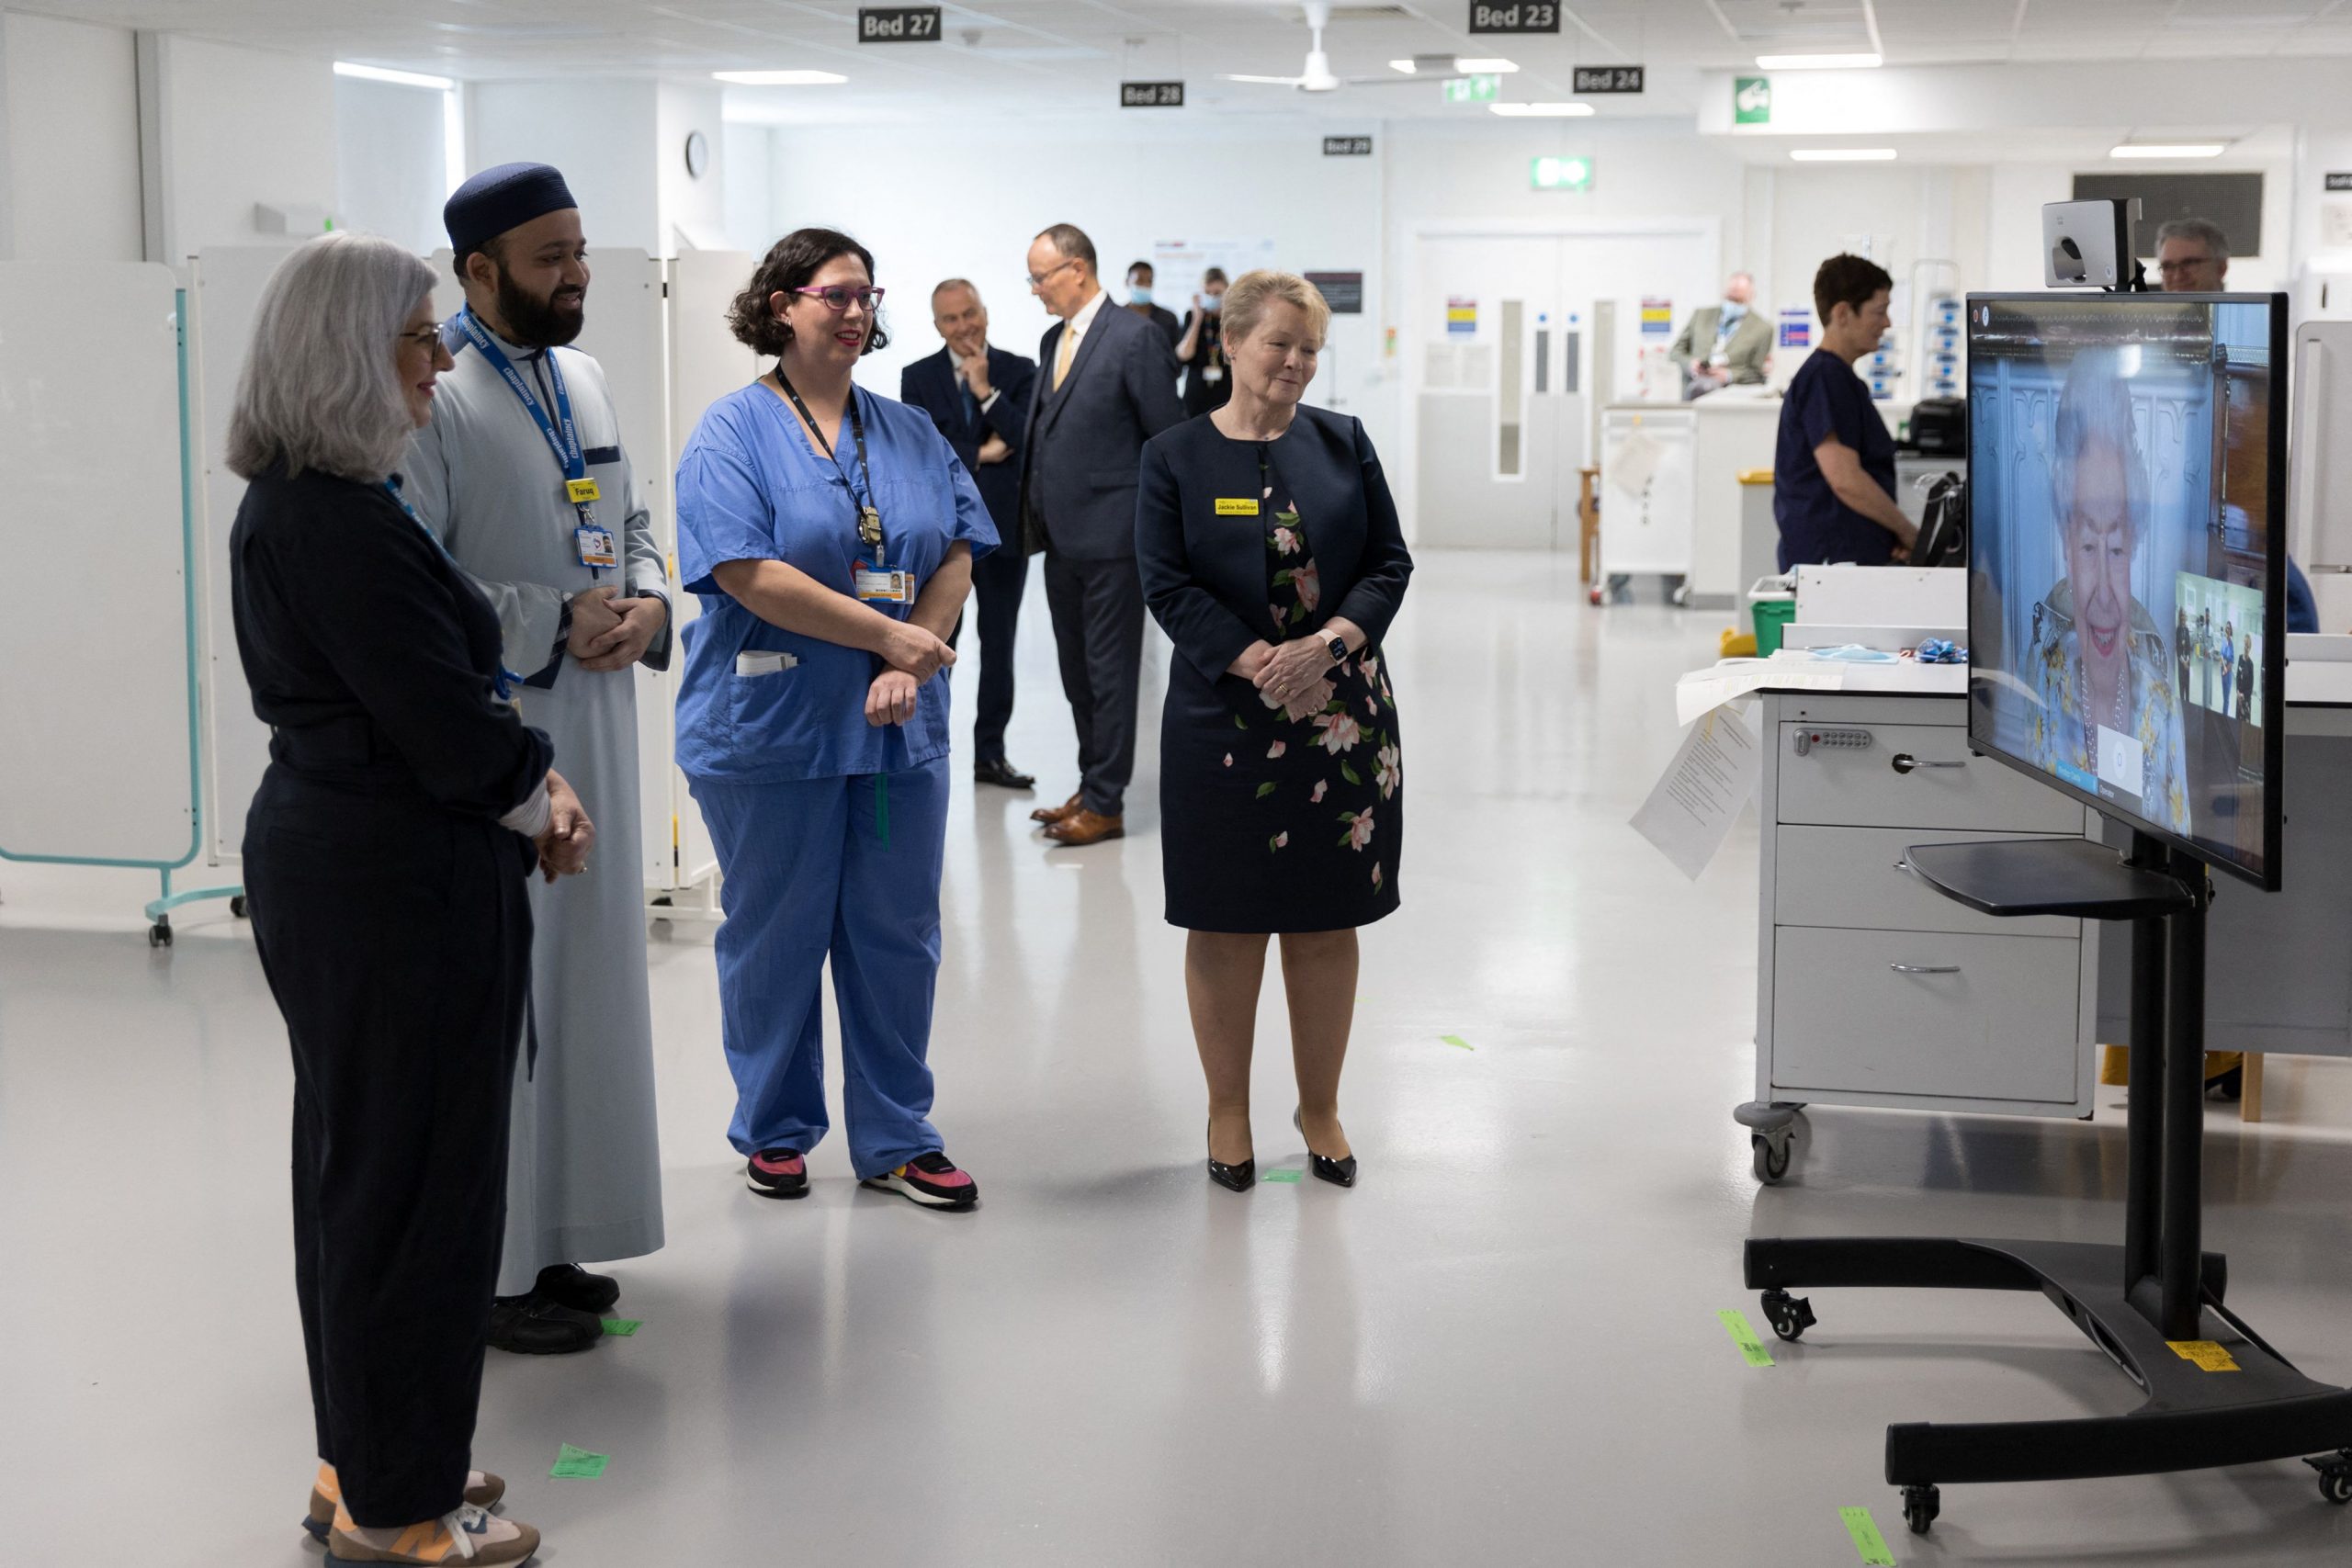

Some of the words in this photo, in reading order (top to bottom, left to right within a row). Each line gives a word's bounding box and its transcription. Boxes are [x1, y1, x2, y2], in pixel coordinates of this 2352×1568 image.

[864, 15, 904, 37] Bed
[909, 14, 935, 36] 27
[1476, 5, 1519, 27] Bed
[1524, 6, 1554, 27] 23
[1577, 70, 1612, 89] Bed
[1616, 70, 1640, 89] 24
[1124, 85, 1156, 104] Bed
[1159, 85, 1181, 104] 28
[1326, 140, 1351, 153] Bed
[462, 315, 490, 349] chaplaincy
[503, 367, 535, 406] chaplaincy
[564, 419, 579, 459] chaplaincy
[575, 487, 594, 496] Faruq
